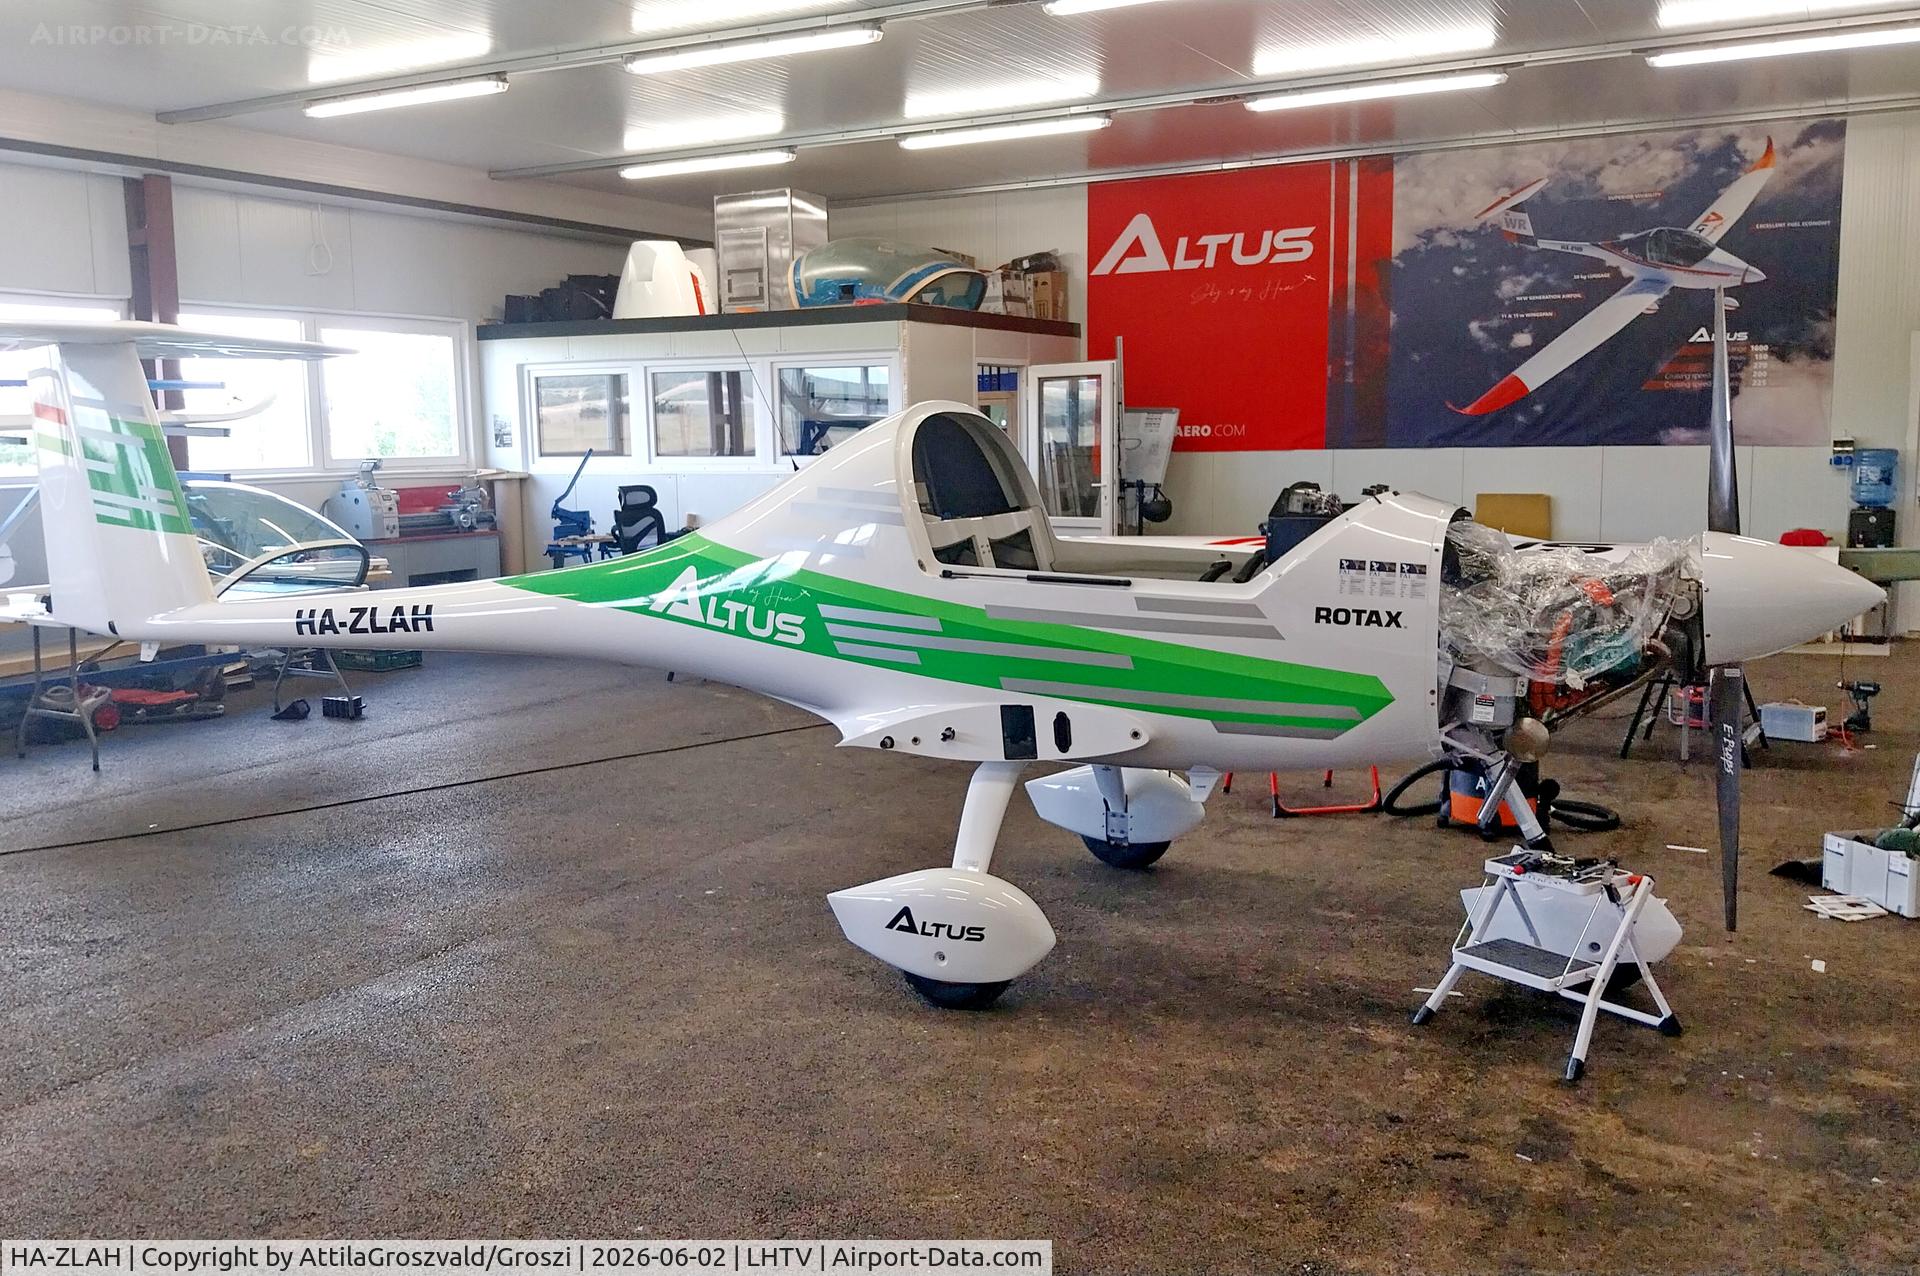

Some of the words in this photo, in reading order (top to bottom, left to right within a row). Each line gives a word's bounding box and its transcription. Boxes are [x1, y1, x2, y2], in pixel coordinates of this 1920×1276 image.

[1504, 217, 1527, 231] WR
[1089, 213, 1317, 276] ALTUS
[295, 604, 434, 635] HA-ZLAH
[649, 565, 807, 645] ALTUS
[1314, 606, 1403, 629] ROTAX
[1720, 723, 1735, 776] E-Props
[885, 905, 986, 942] ALTUS
